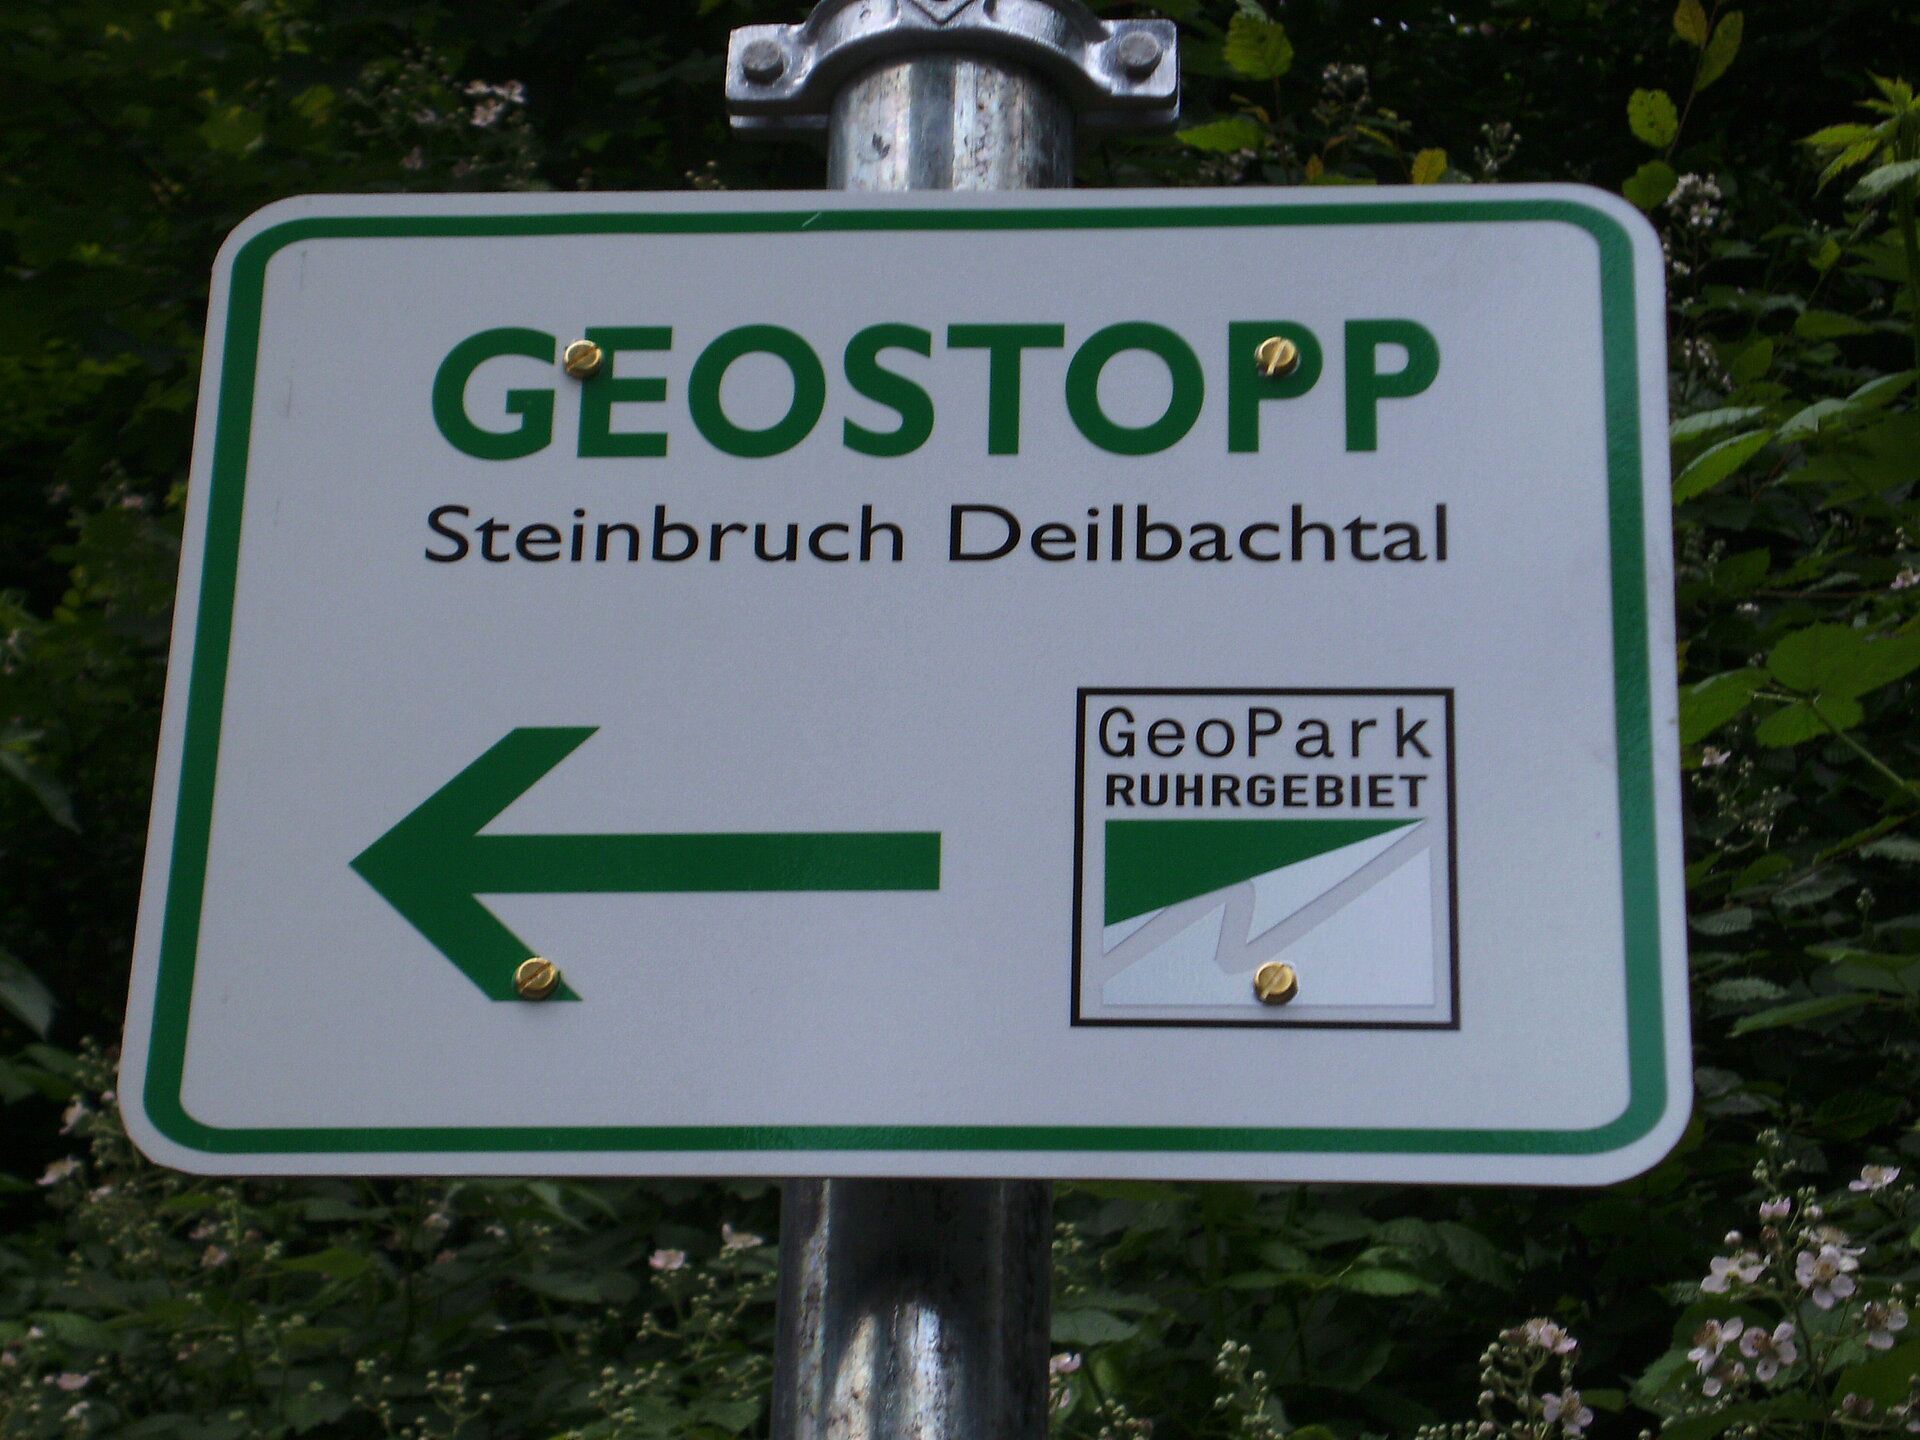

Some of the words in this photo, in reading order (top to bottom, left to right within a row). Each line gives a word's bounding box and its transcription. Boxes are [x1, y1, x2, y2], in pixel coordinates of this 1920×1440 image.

[431, 319, 1441, 462] GEOSTOPP
[424, 503, 904, 564] Steinbruch
[948, 503, 1447, 563] Deilbachtal
[1098, 706, 1432, 759] GeoPark
[1105, 773, 1428, 808] RUHRGEBIET
